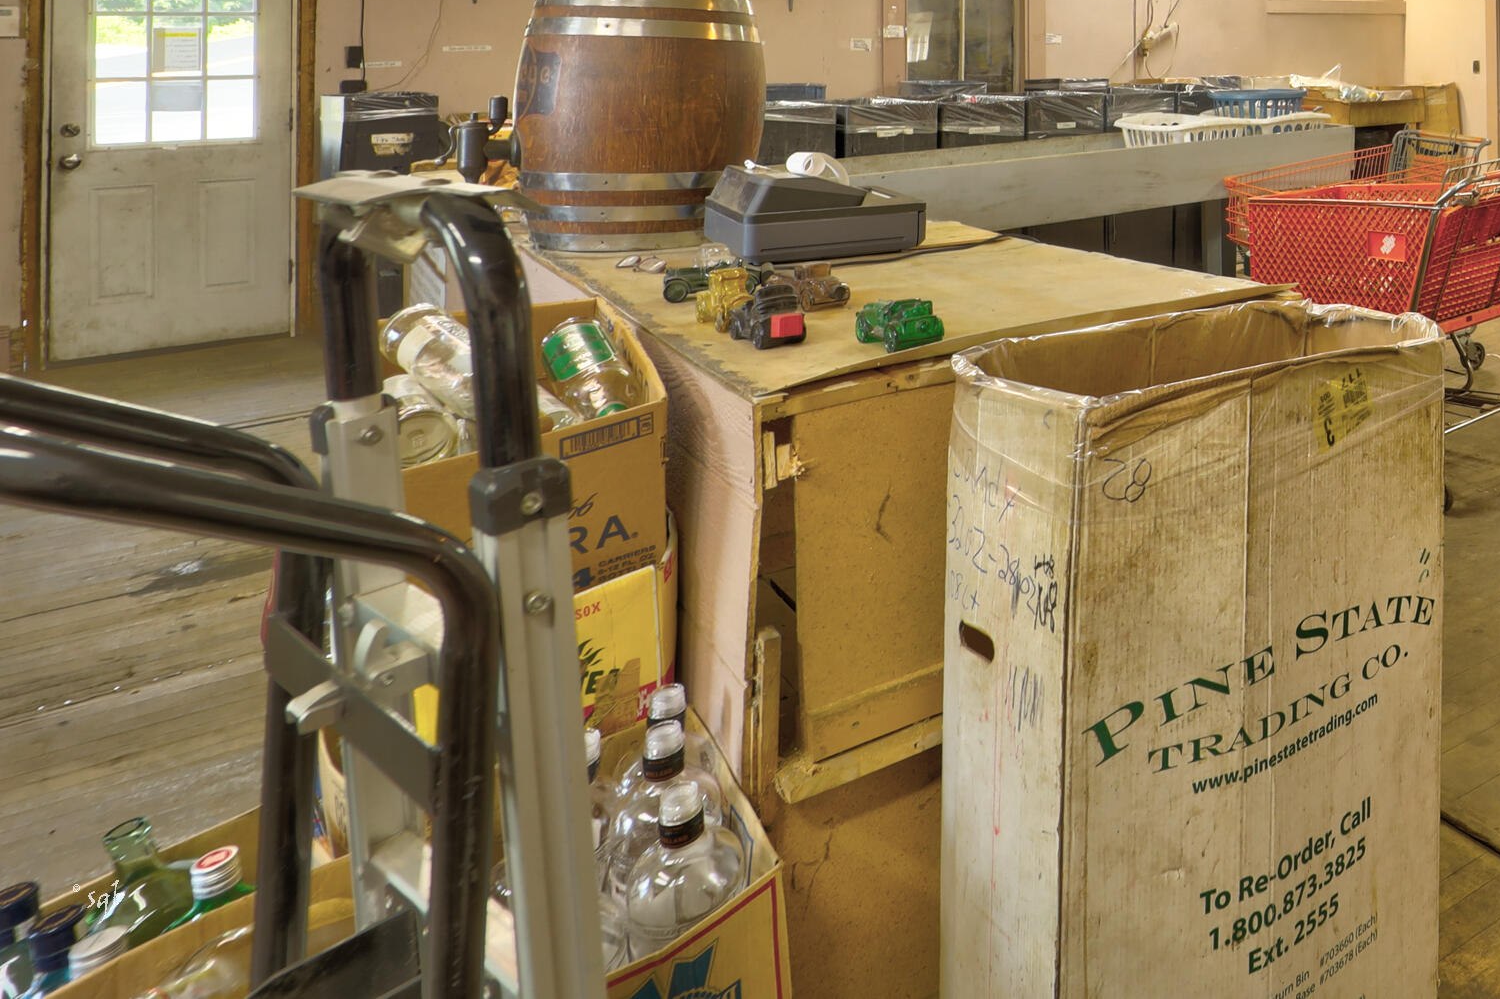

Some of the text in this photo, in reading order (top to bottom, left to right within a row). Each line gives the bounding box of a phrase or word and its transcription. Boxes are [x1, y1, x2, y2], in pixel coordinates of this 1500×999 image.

[598, 545, 656, 568] CARRIERS
[575, 601, 601, 620] SOX
[1081, 595, 1436, 768] PINE STATE
[1148, 644, 1409, 775] TRADING CO.
[1192, 693, 1379, 794] www.pinestatetrading.com
[1200, 796, 1371, 915] To Re-Order, Call
[1209, 836, 1366, 951] 1.800.873.3825
[1249, 893, 1339, 975] Ext. 2555
[1296, 970, 1310, 988] Bin
[1319, 932, 1354, 968] #703660
[1355, 912, 1378, 940] (Each)
[1319, 950, 1354, 986] #703678
[1355, 930, 1378, 957] (Each)
